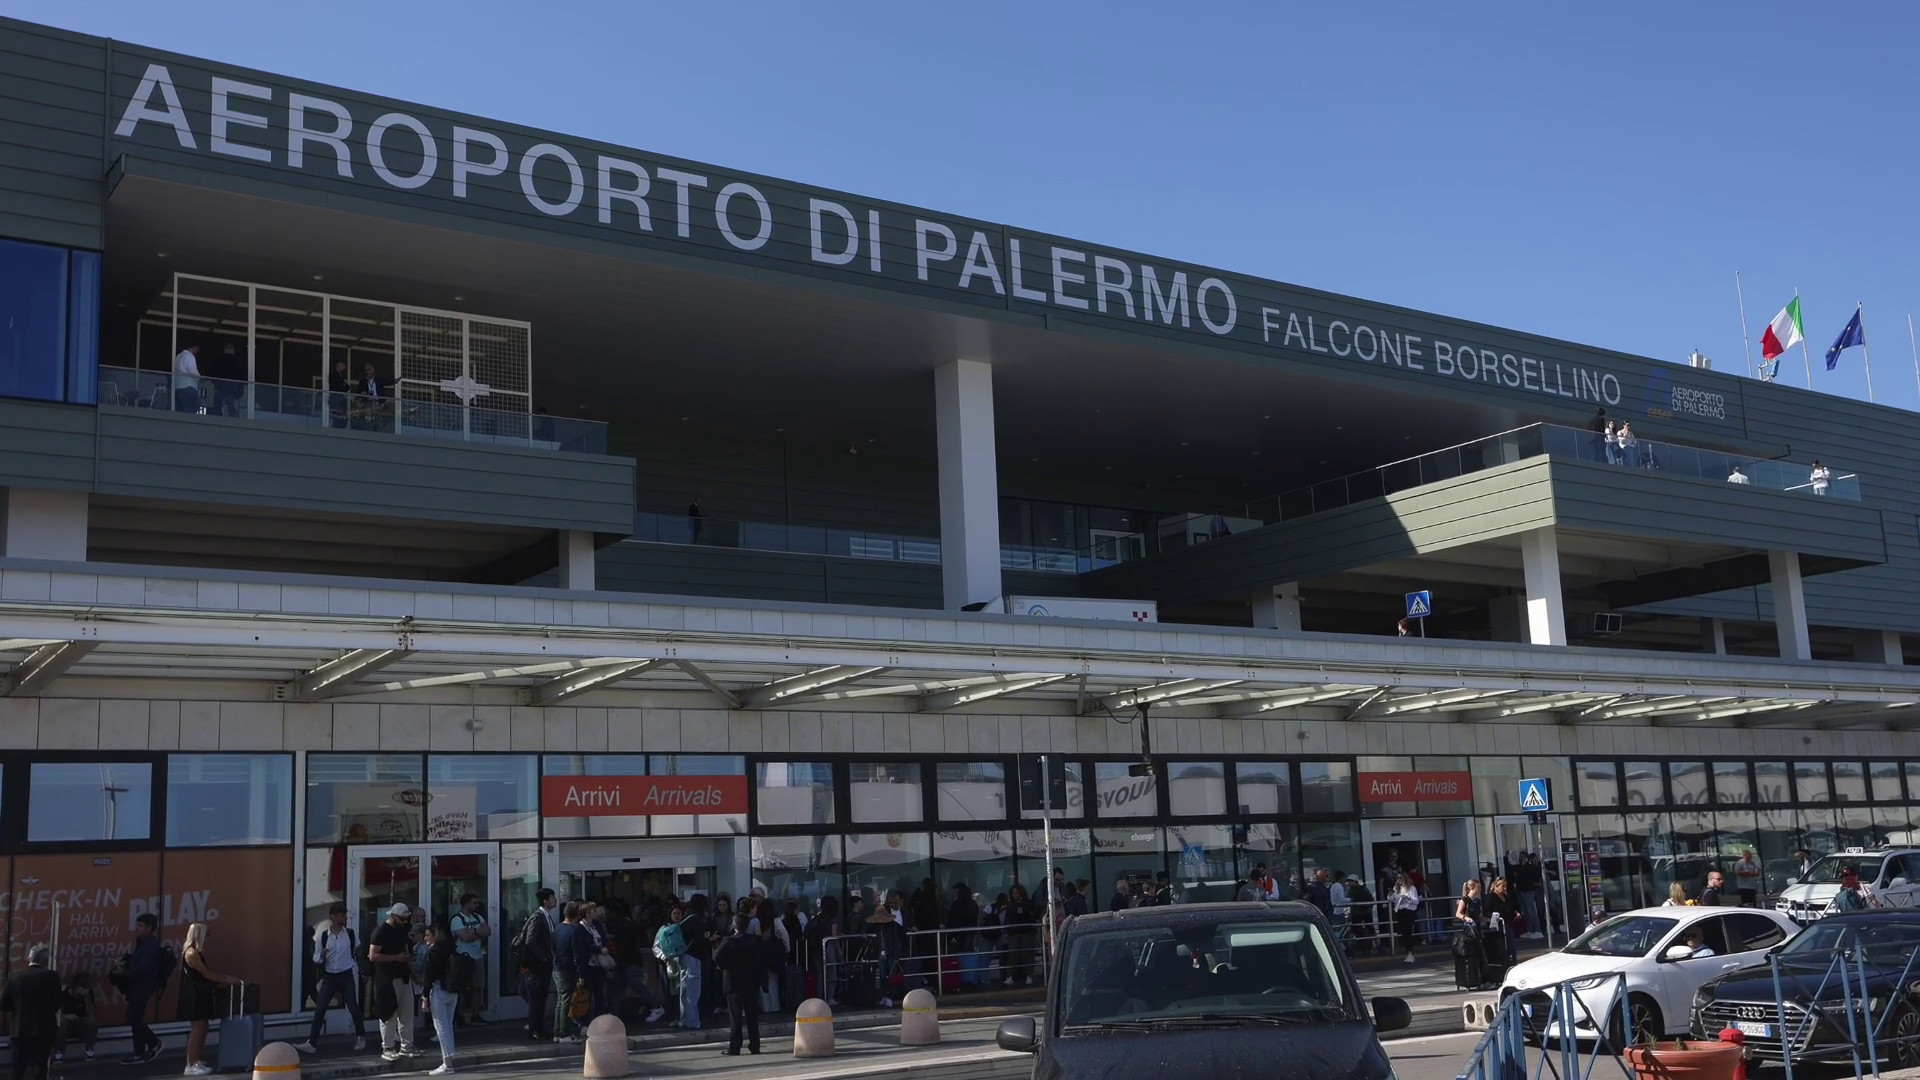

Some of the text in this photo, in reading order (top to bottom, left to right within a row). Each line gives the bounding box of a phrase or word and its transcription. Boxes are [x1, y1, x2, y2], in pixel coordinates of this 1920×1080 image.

[115, 64, 1621, 405] AEROPORTO DI PALERMO FALCONE BORSELLINO
[1672, 386, 1724, 407] AEROPORTO
[1672, 399, 1726, 420] DI PALERMO
[565, 785, 722, 806] Arrivi Arrivals
[1371, 779, 1457, 795] Arrivi Arrivals
[1131, 833, 1155, 843] change
[0, 888, 122, 912] CHECK-IN
[70, 912, 106, 926] HALL
[67, 926, 119, 939] ARRIVI
